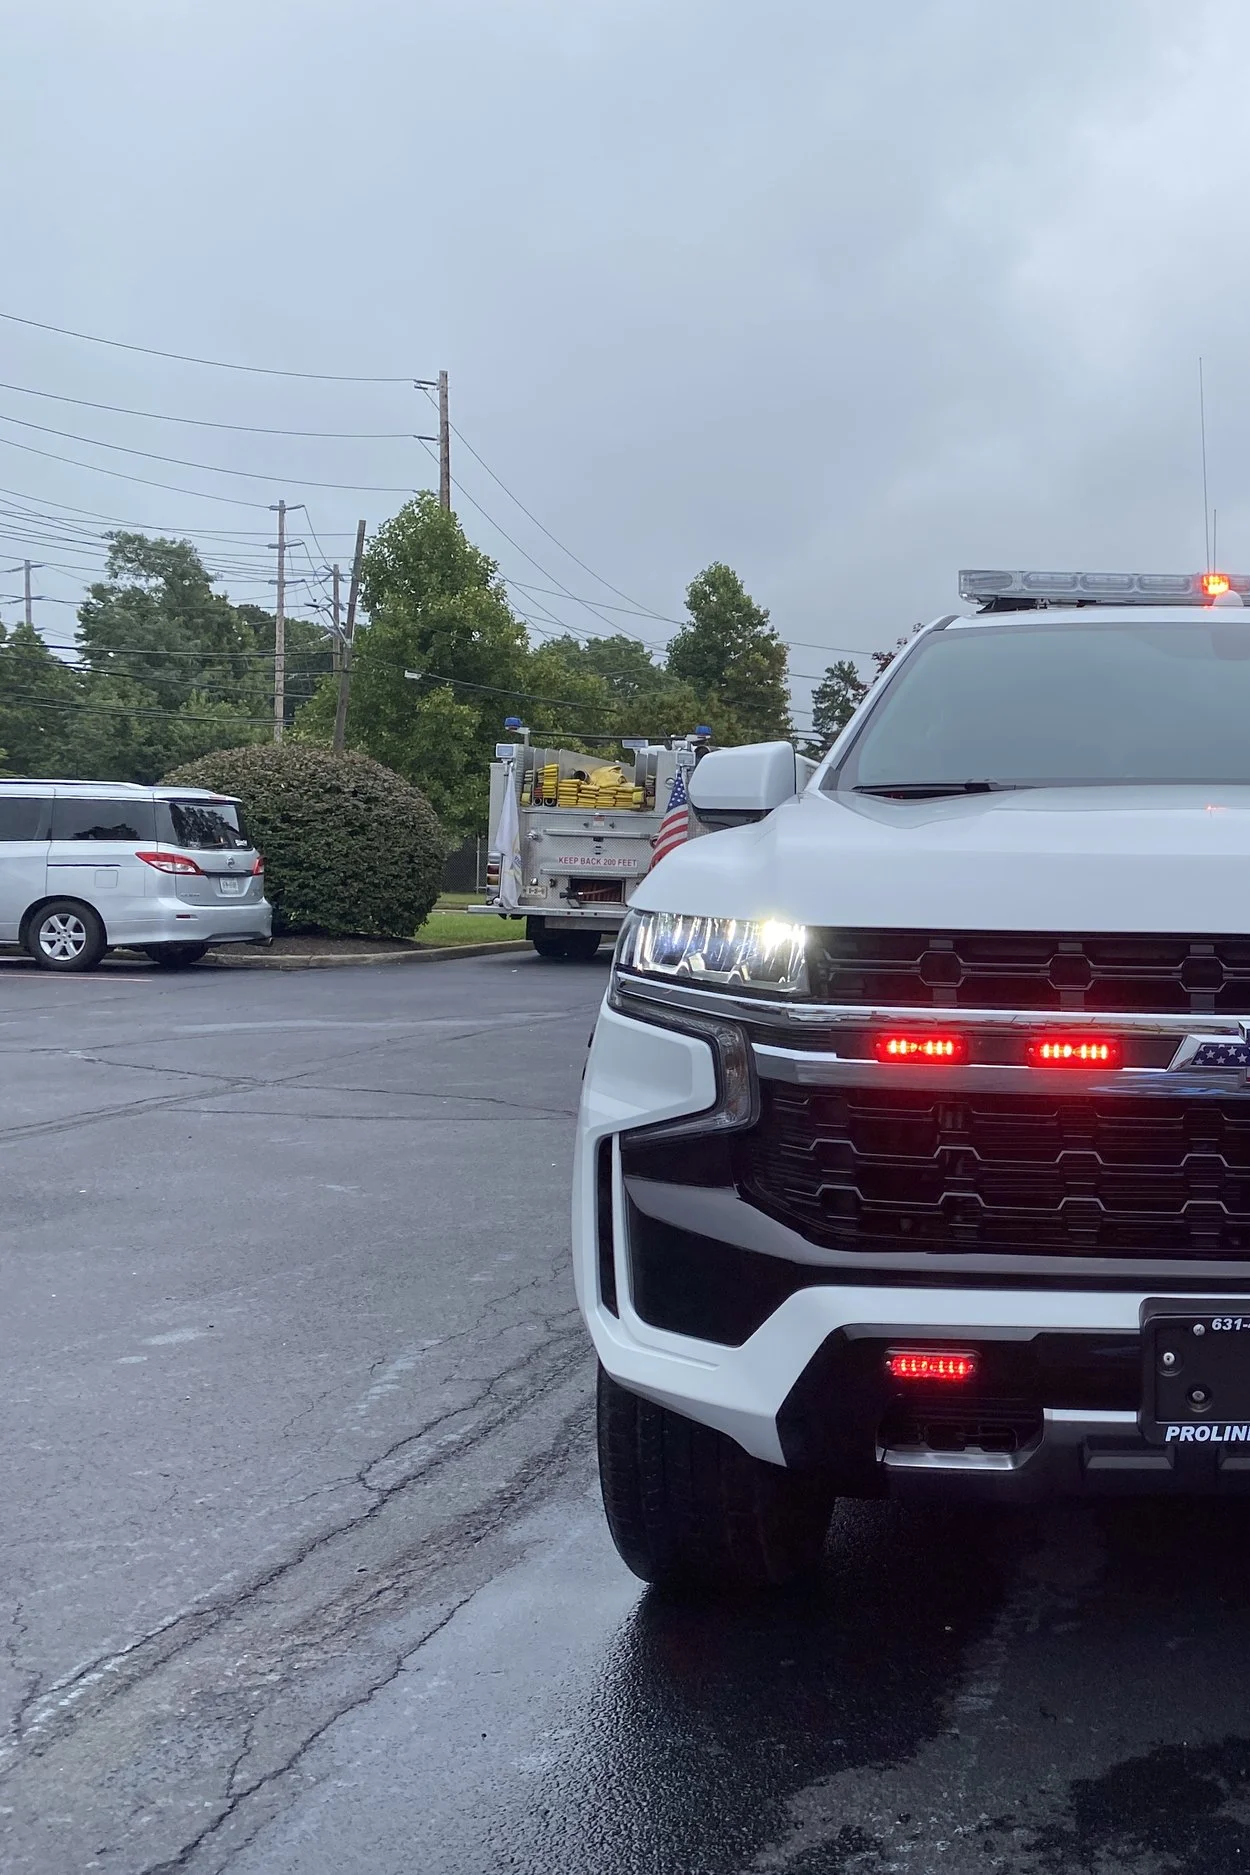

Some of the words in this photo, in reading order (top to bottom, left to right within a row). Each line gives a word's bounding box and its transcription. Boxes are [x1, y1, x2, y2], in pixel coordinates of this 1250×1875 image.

[558, 857, 579, 865] KEEP
[580, 857, 601, 866] BACK
[617, 859, 638, 867] FEET
